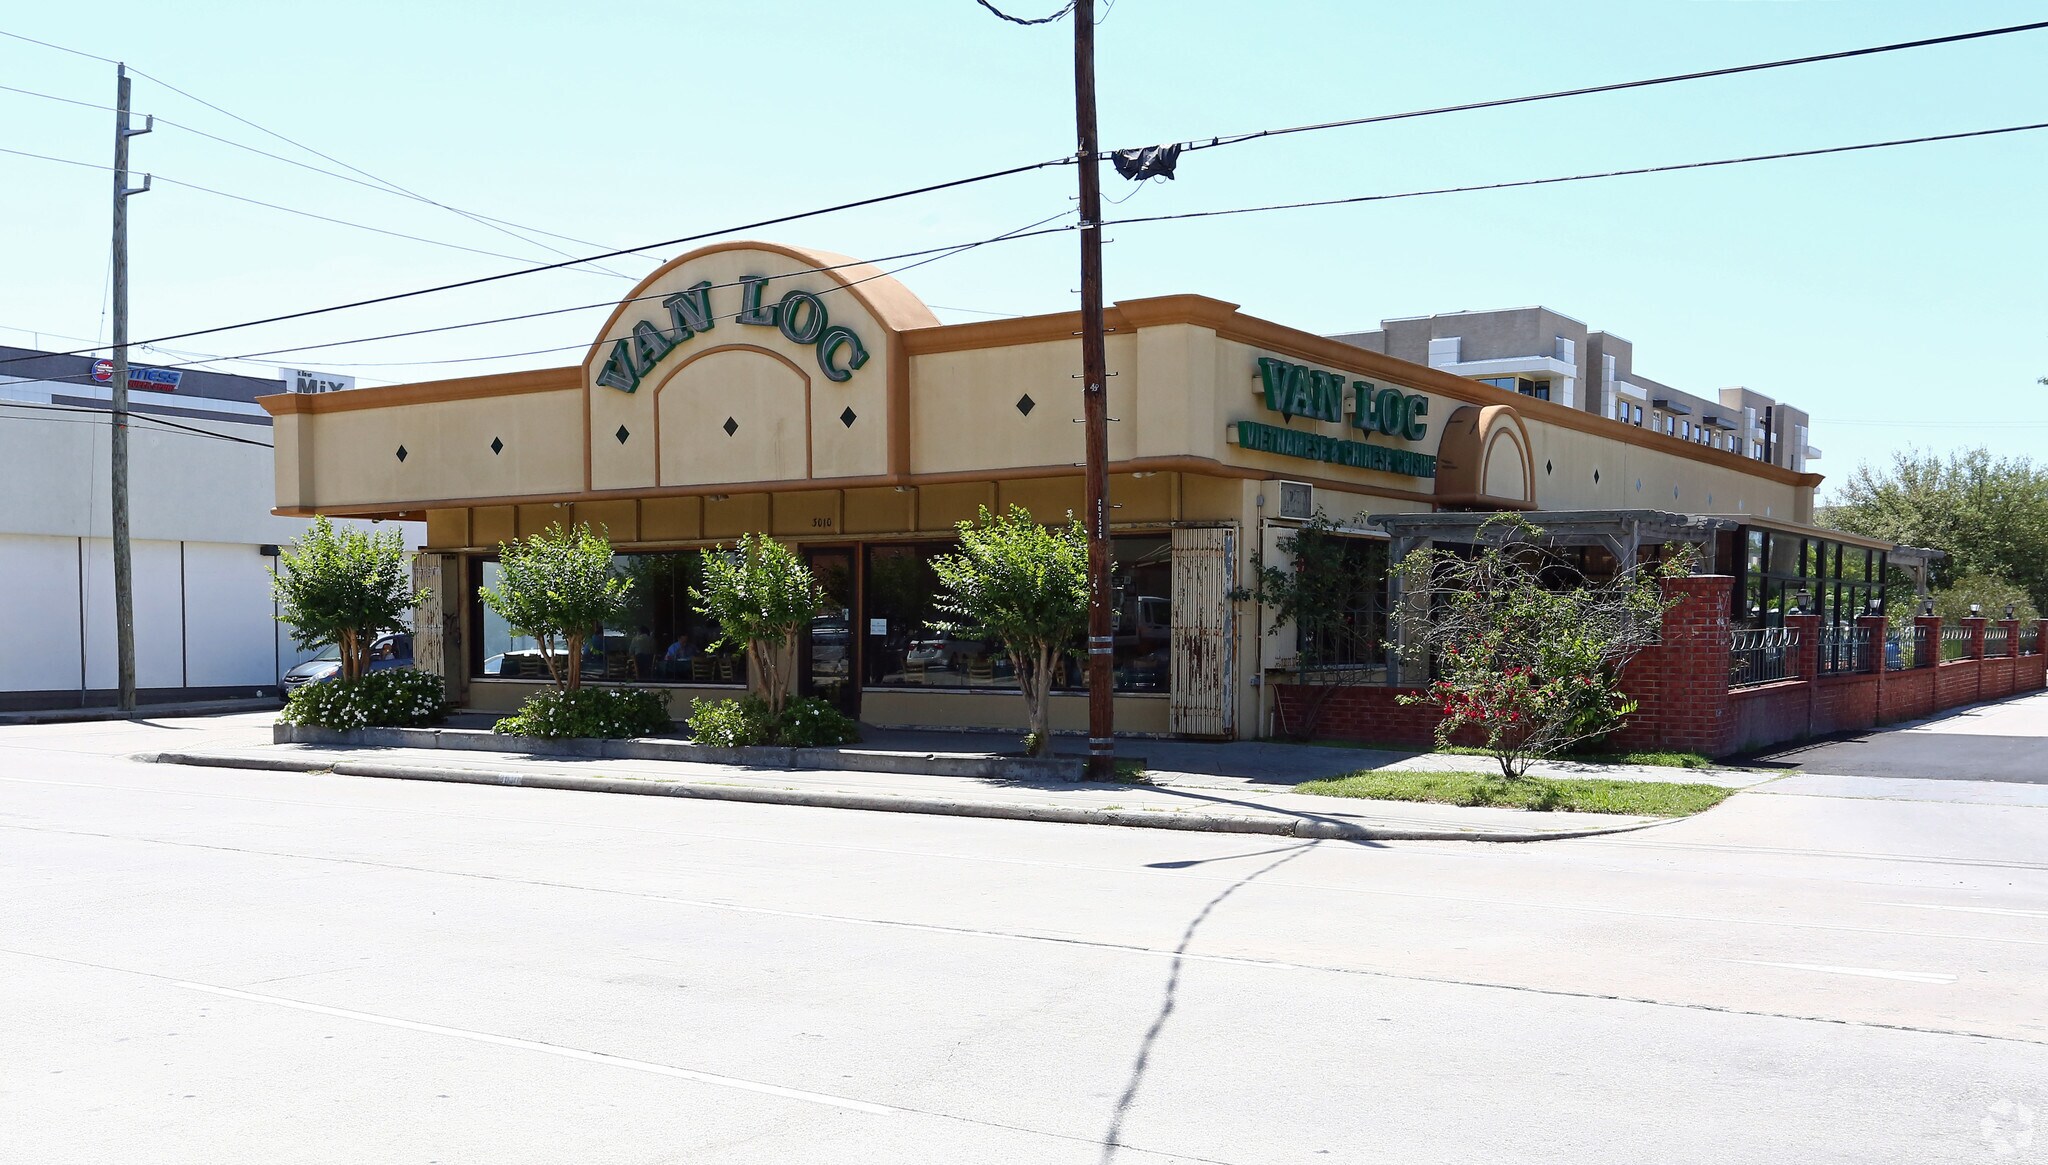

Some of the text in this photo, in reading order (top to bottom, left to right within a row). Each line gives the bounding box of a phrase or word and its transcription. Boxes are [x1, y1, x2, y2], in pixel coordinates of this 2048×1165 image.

[596, 275, 870, 394] VAN LOC
[1258, 357, 1428, 441] VAN LOC
[1238, 421, 1328, 461] VIETNAMESE
[1338, 440, 1392, 471] CHINESE
[1392, 449, 1437, 478] CUISINE
[811, 517, 832, 528] 3010
